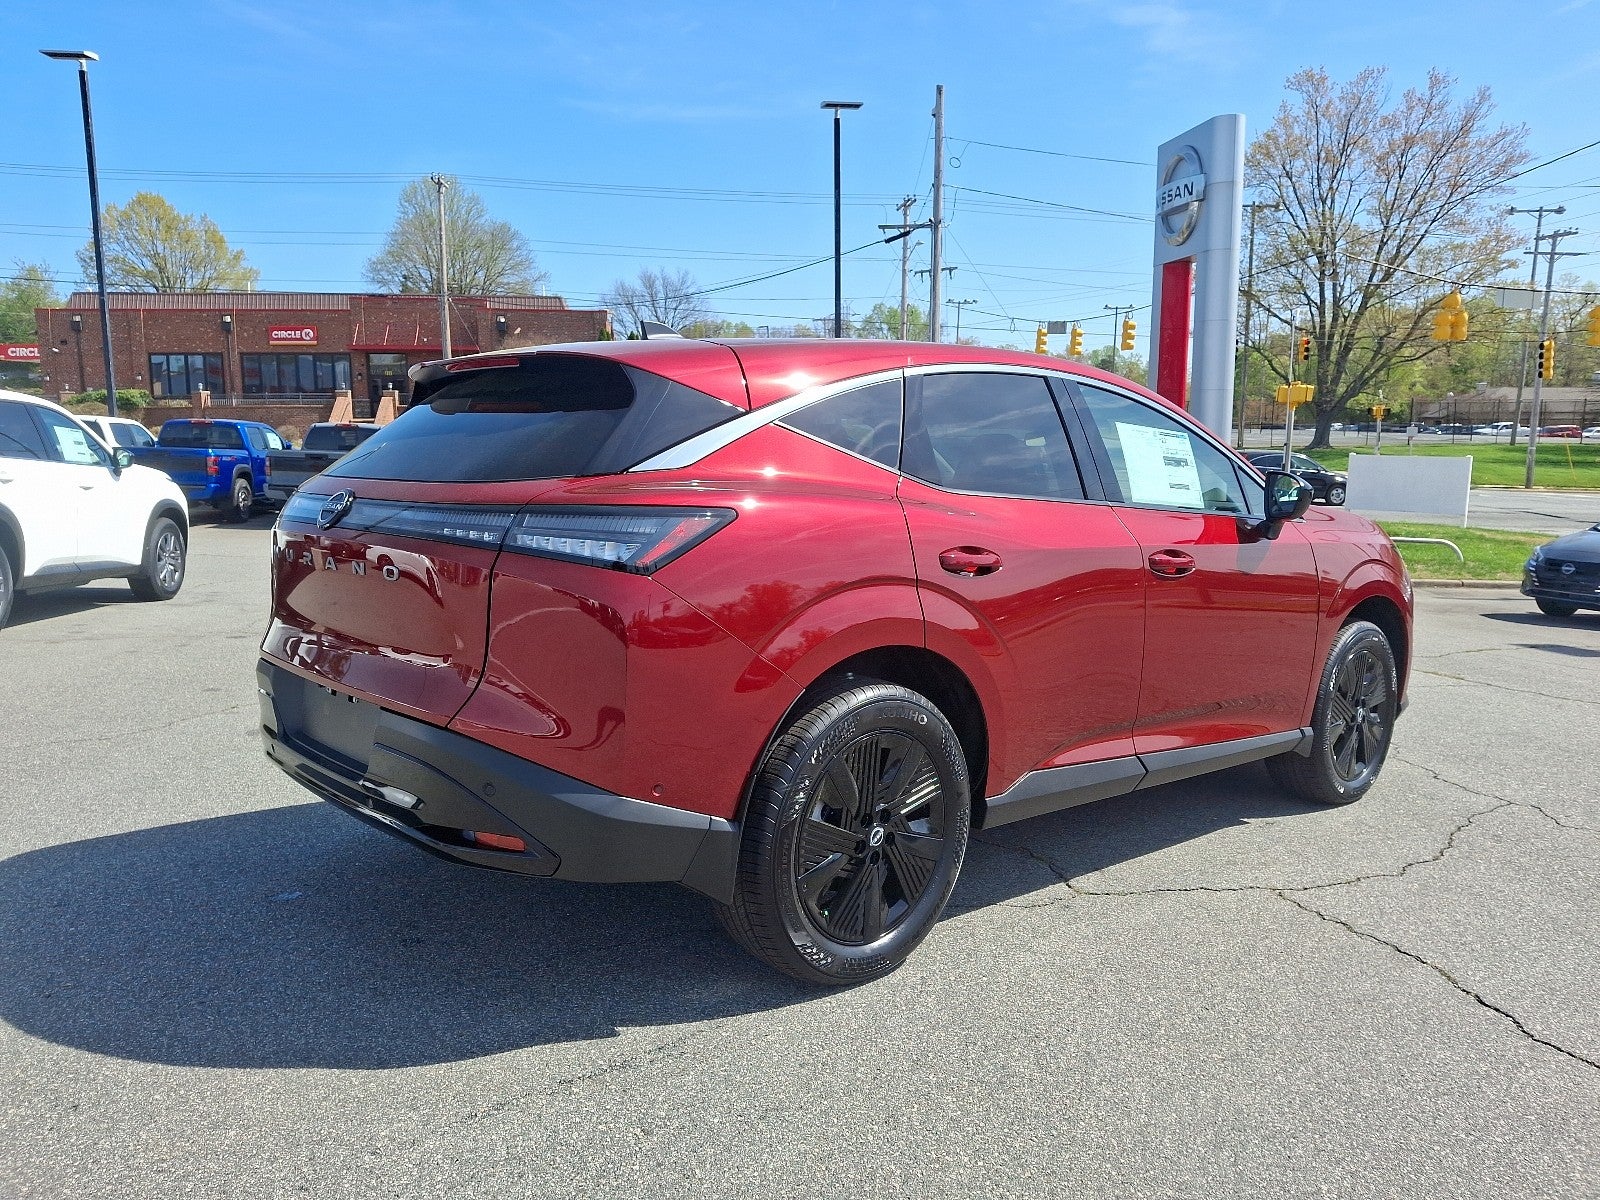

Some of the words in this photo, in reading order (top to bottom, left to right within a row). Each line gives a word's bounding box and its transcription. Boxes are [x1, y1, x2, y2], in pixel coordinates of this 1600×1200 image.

[1157, 181, 1194, 209] SSAN
[272, 330, 301, 338] CIRCLE
[7, 347, 40, 357] CIRCL
